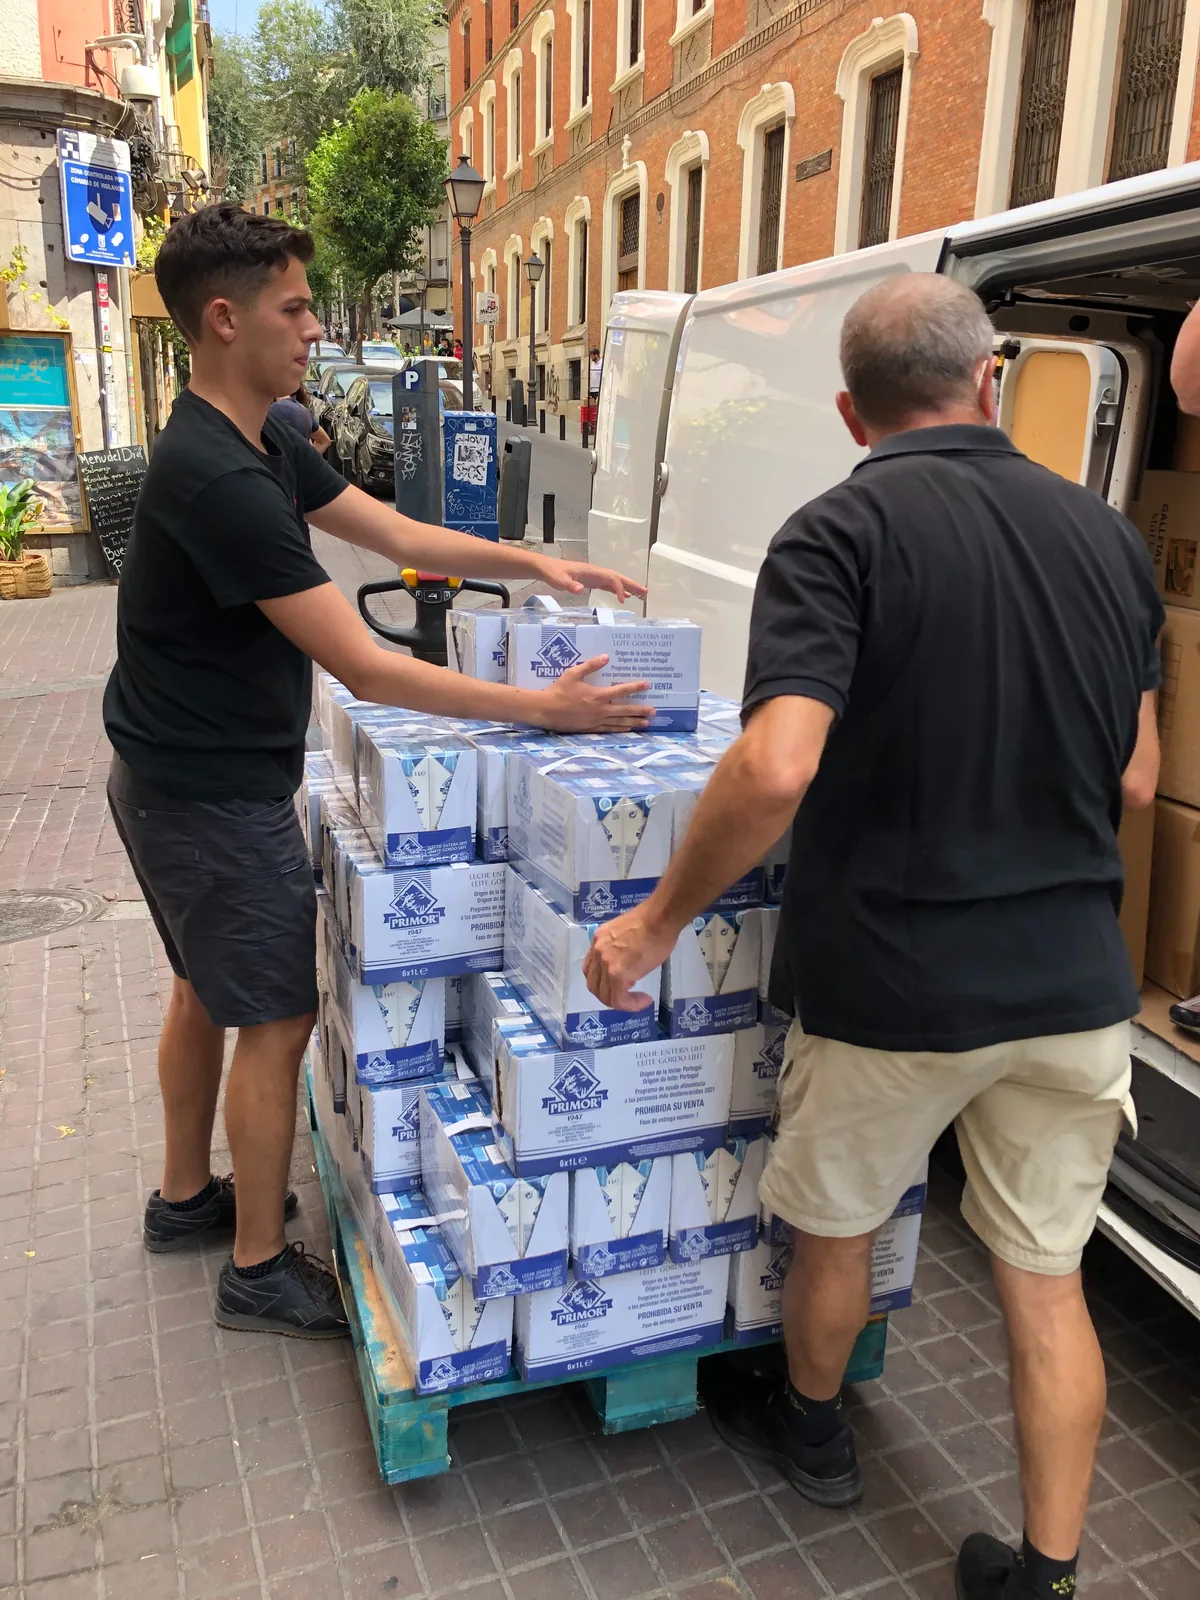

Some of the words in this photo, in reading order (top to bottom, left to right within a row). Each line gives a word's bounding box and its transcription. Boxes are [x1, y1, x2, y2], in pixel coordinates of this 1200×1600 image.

[84, 170, 113, 181] CONTROLADA
[406, 371, 419, 390] P
[108, 449, 121, 462] del
[1154, 503, 1169, 565] GALLETAS
[538, 668, 566, 677] PRIM
[654, 682, 673, 690] VENTA
[469, 872, 490, 880] LECHE
[491, 878, 505, 886] GOR
[470, 906, 492, 914] Programa
[391, 916, 438, 929] PRIMOR
[471, 921, 505, 932] PROHIBIDA
[660, 1047, 688, 1056] ENTERA
[658, 1055, 686, 1064] GORDO
[704, 1086, 715, 1094] 2021
[550, 1100, 598, 1114] PRIMOR
[635, 1103, 672, 1116] PROHIBIDA
[673, 1102, 682, 1110] SU
[684, 1099, 704, 1109] VENTA
[401, 1129, 420, 1140] PRI
[559, 1159, 577, 1167] 6x1L
[410, 1178, 421, 1186] 6x1
[877, 1268, 894, 1278] VENTA
[638, 1307, 672, 1320] PROHIBIDA
[673, 1305, 682, 1313] SU
[683, 1301, 703, 1311] VENTA
[559, 1308, 603, 1325] PRIMOR
[567, 1361, 583, 1371] 6x1L
